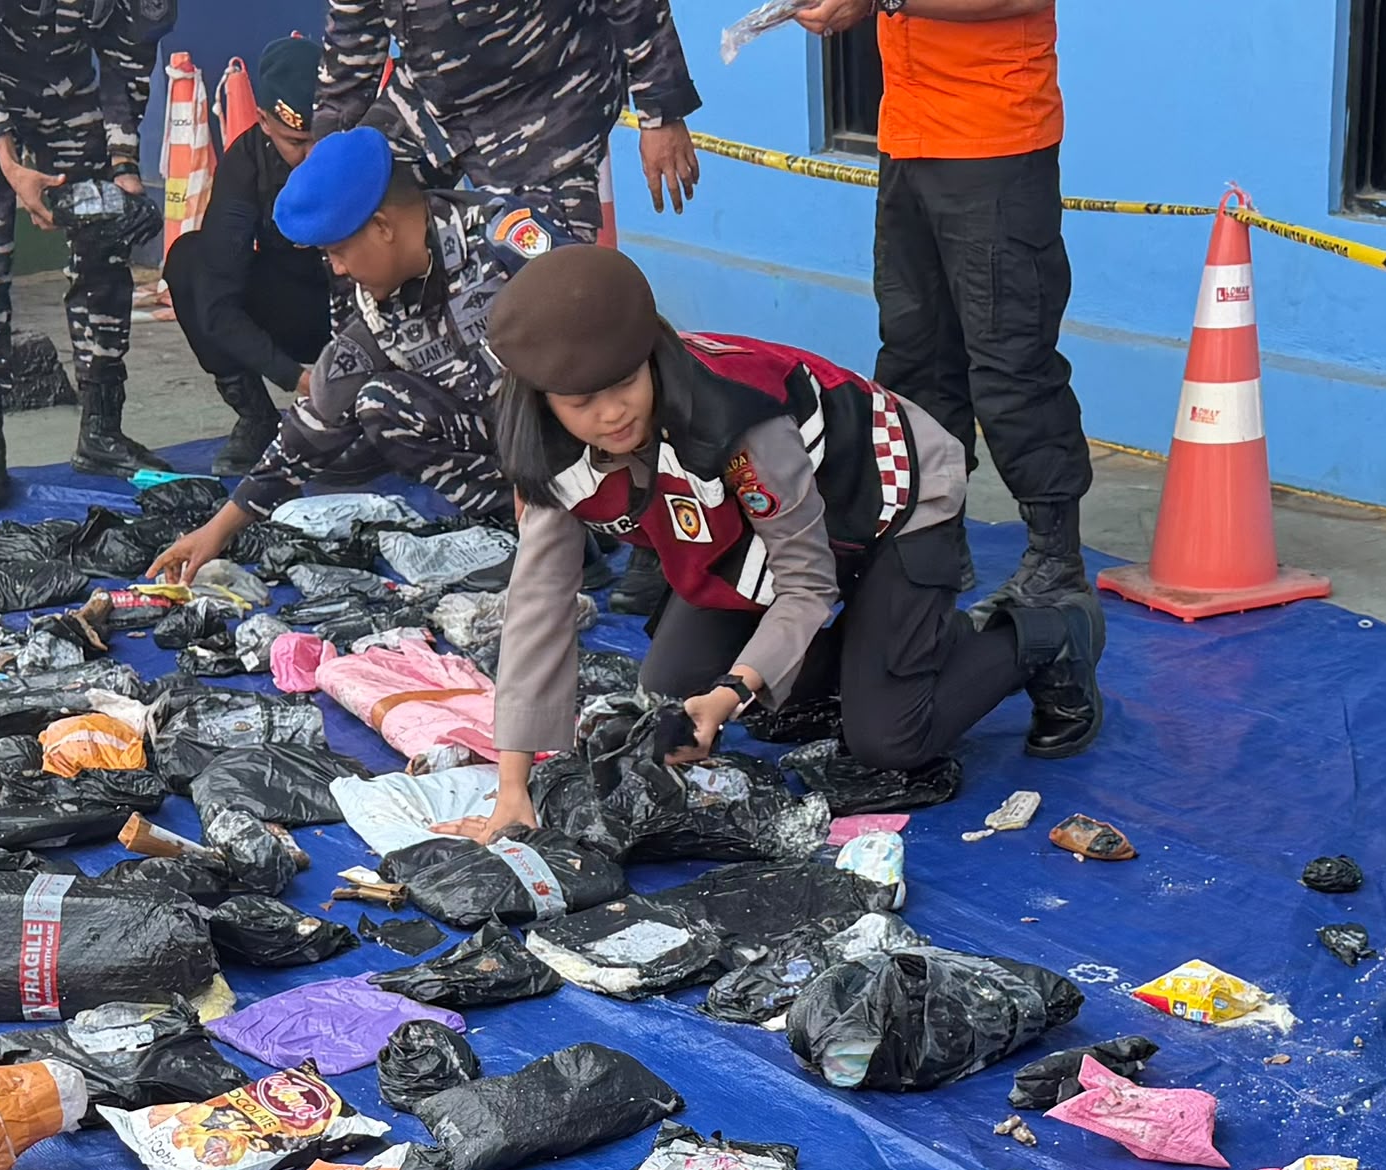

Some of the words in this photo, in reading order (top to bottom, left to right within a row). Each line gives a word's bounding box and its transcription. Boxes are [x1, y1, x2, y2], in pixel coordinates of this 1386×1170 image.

[46, 923, 55, 947] CARE
[23, 923, 44, 1003] FRAGILE
[44, 948, 53, 970] WITH
